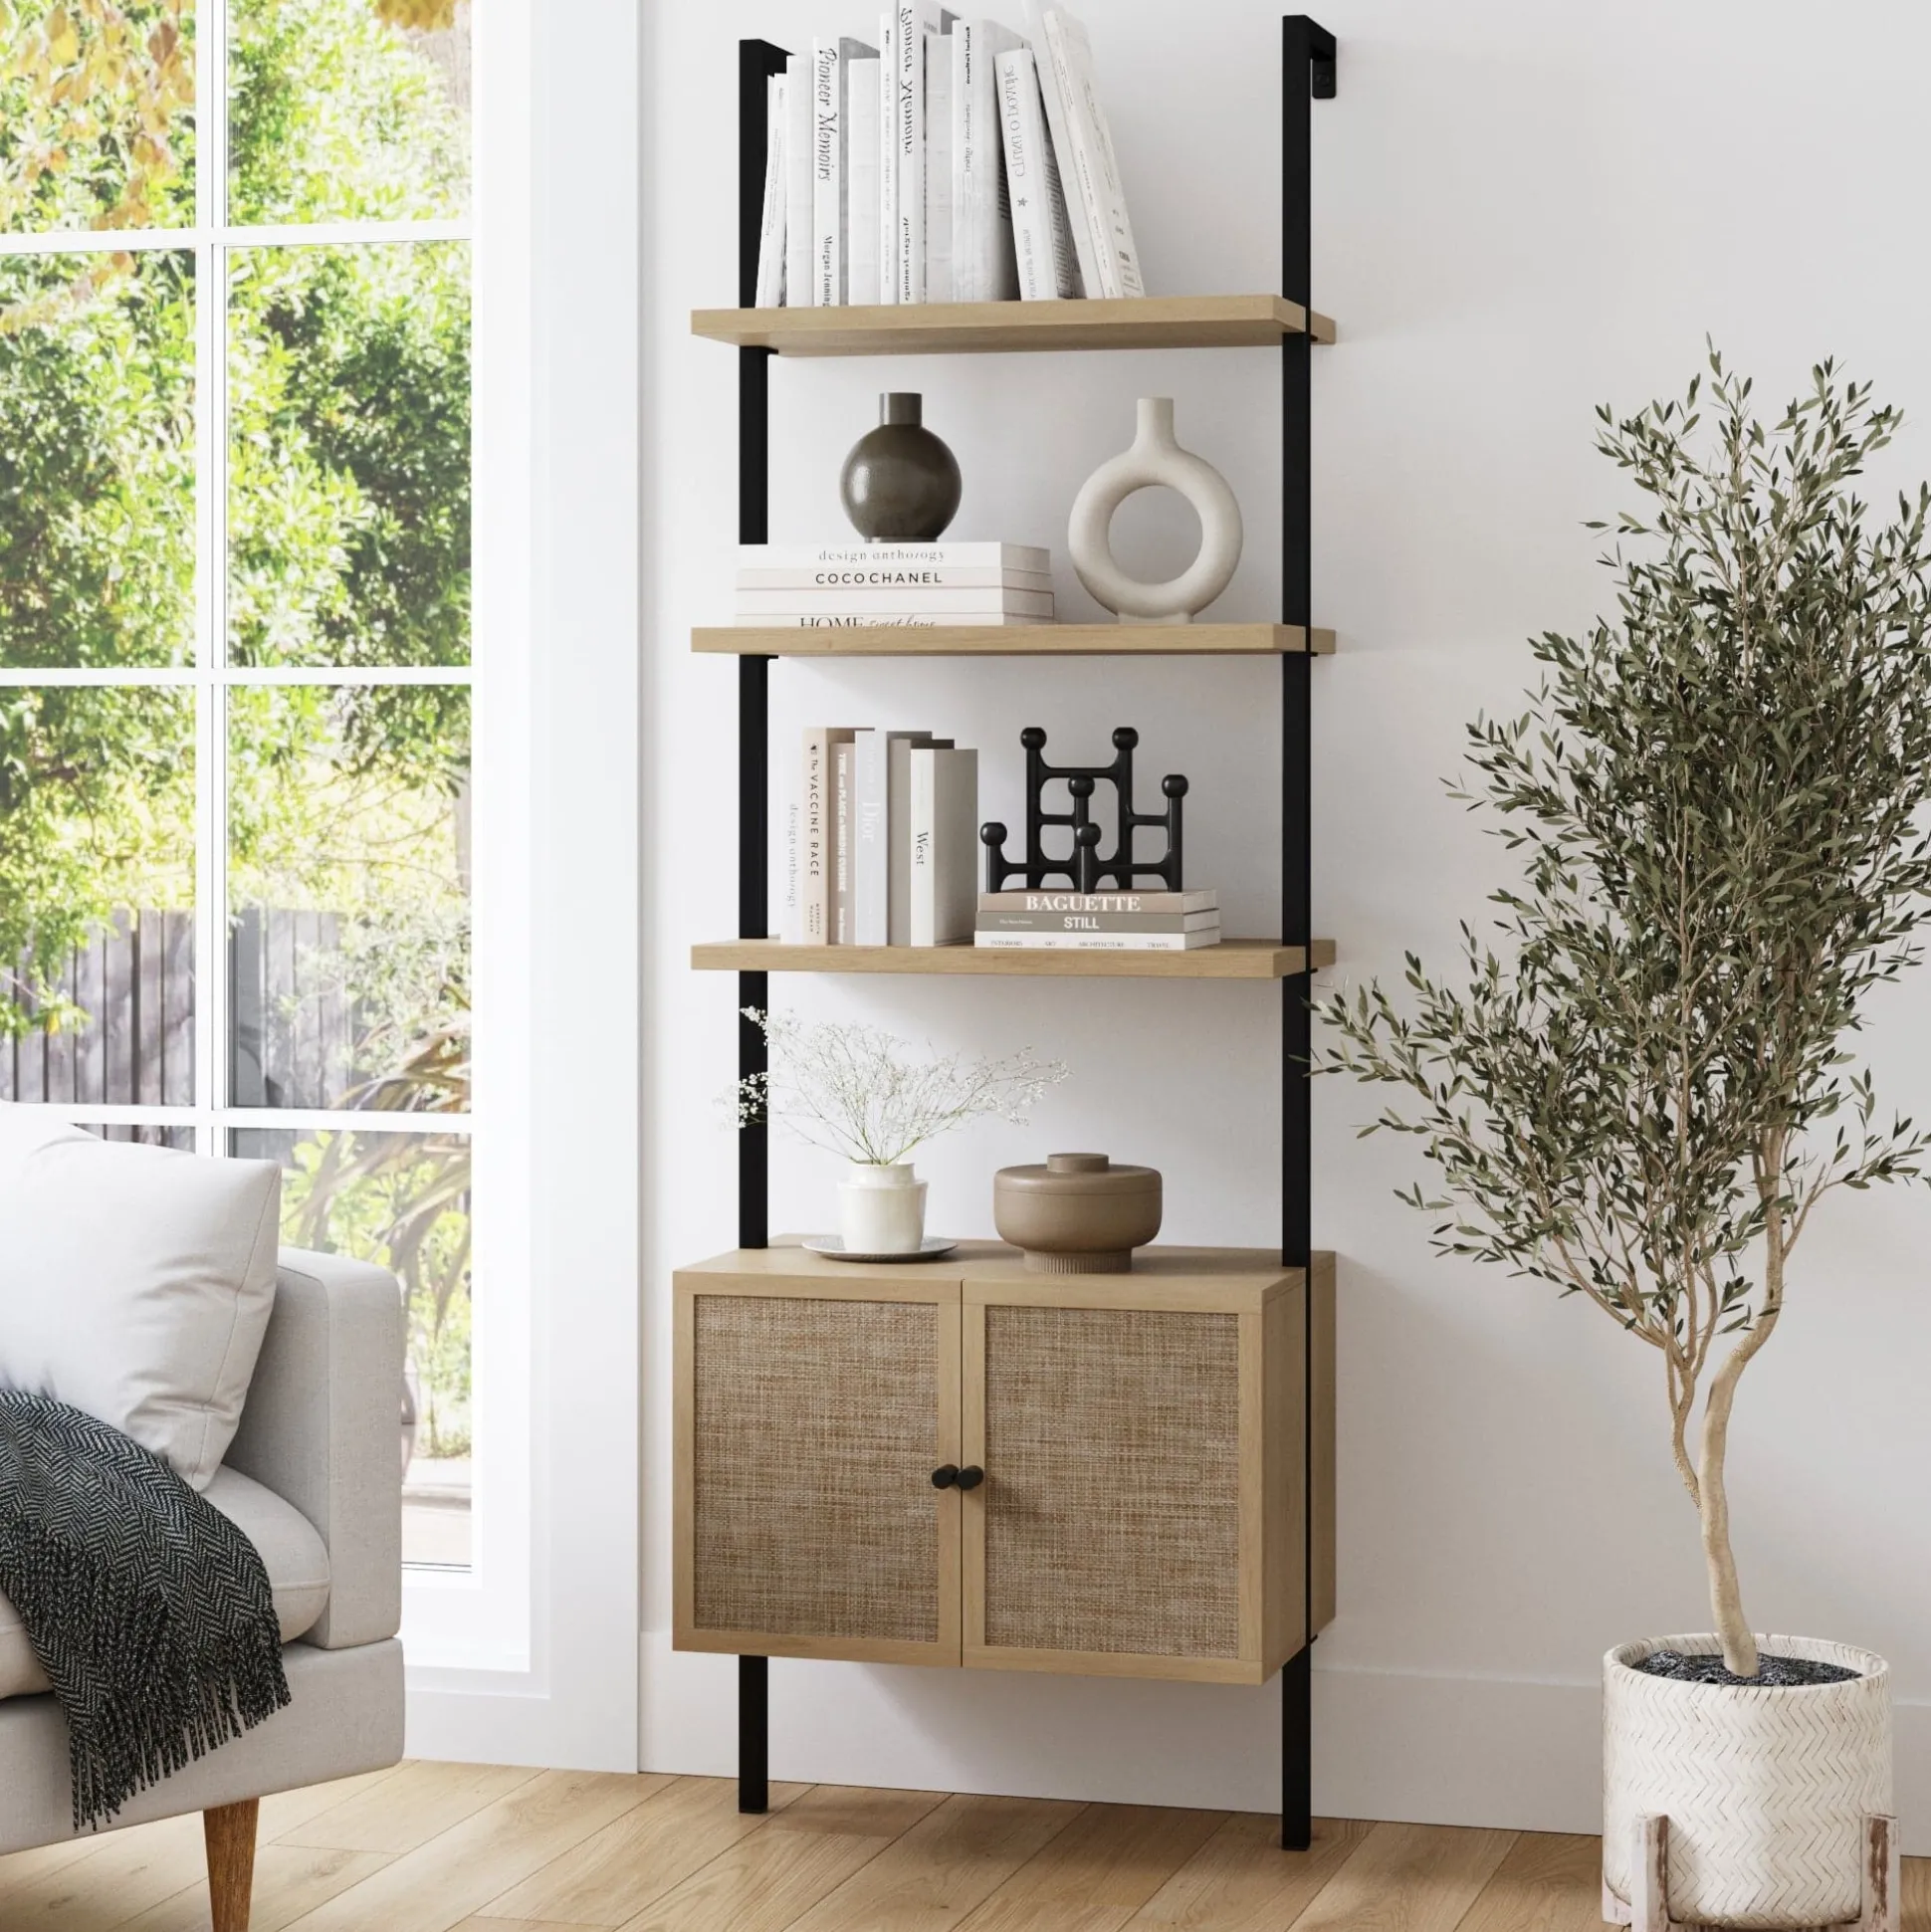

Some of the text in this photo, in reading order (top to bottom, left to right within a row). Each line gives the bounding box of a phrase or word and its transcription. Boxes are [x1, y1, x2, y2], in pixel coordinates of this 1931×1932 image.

[818, 48, 838, 182] Pioneer Memoirs
[822, 236, 833, 307] Morgan Jenning
[819, 549, 945, 563] design anthology
[800, 616, 864, 628] HOME
[787, 803, 799, 844] design
[809, 759, 819, 877] The VACCINE RACE
[860, 801, 881, 843] Dior
[916, 831, 929, 867] West
[1025, 896, 1142, 912] BAGUETTE
[1063, 916, 1100, 929] STILL
